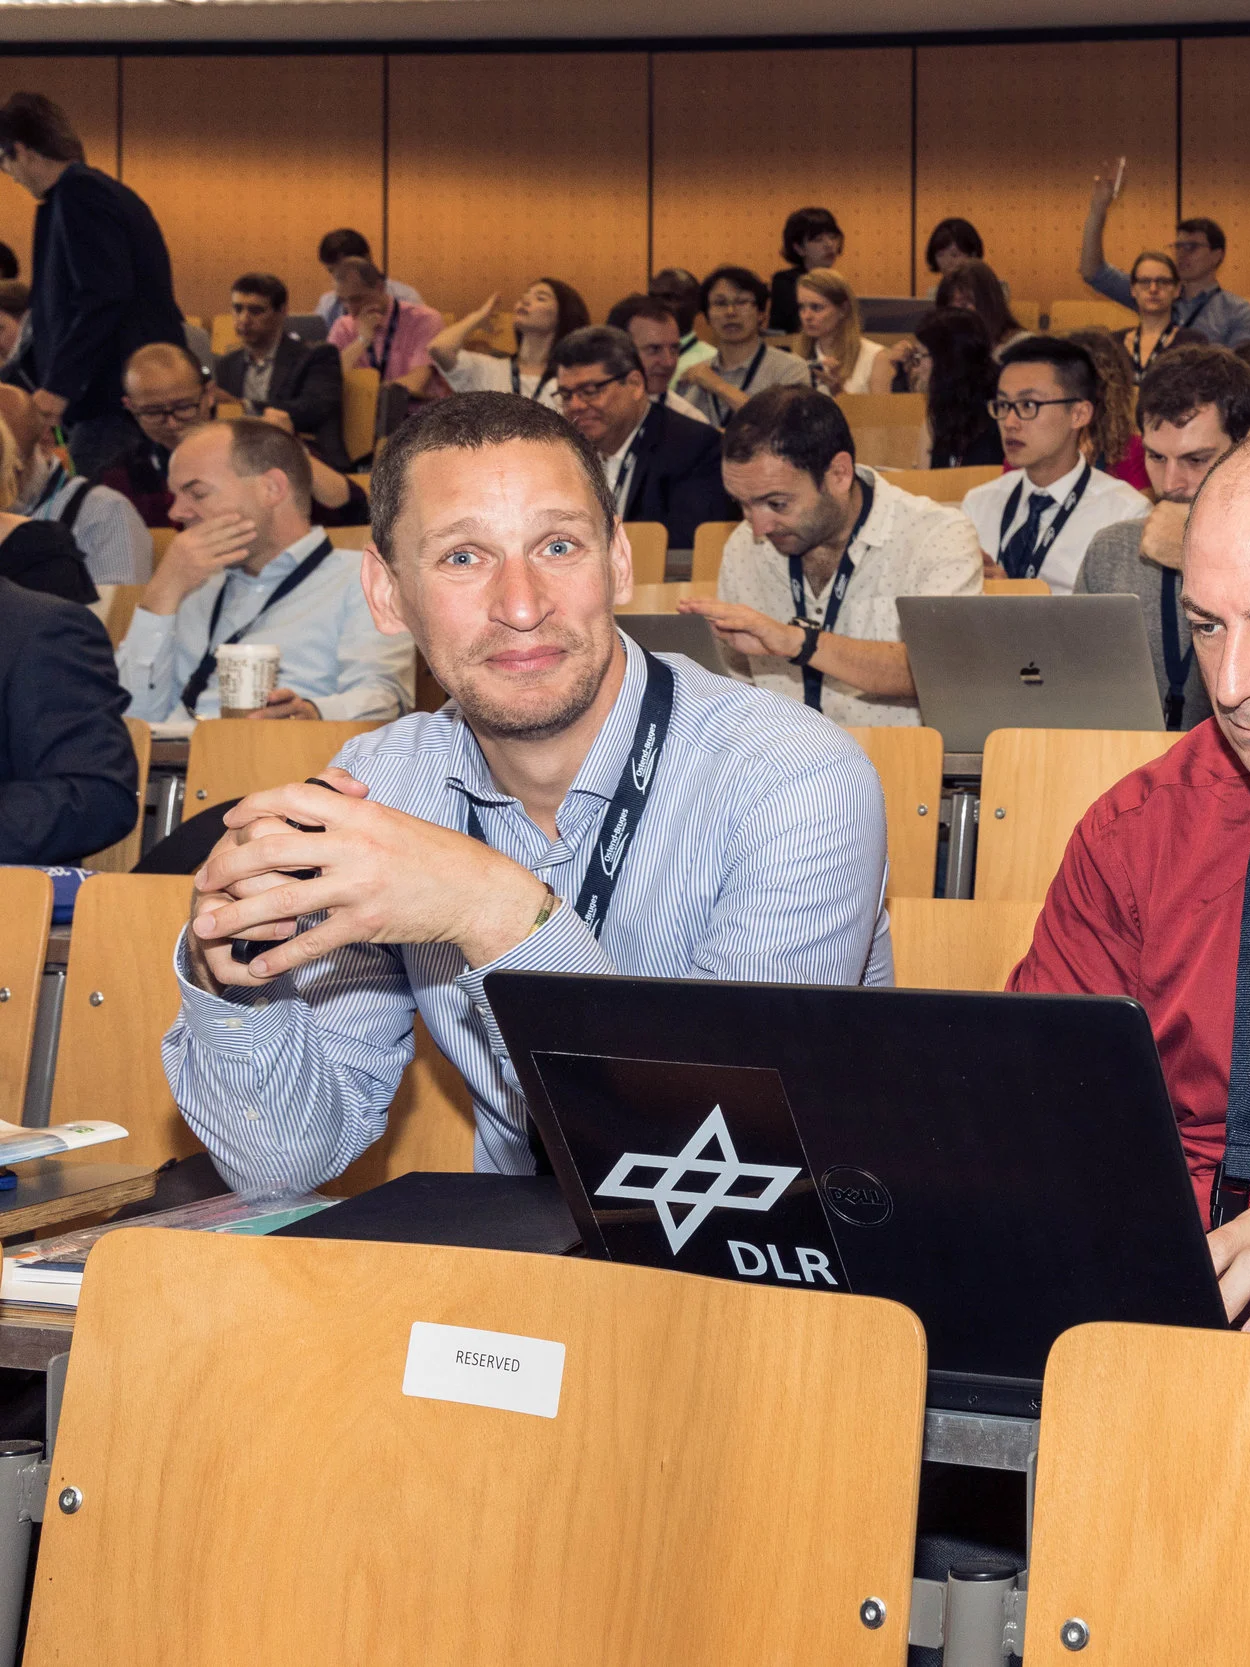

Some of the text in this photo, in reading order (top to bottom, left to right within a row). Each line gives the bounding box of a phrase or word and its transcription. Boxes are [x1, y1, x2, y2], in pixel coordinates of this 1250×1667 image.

[636, 723, 656, 776] Ostend-Bruges
[604, 808, 628, 862] Ostend-Bruges
[828, 1186, 887, 1206] DELL
[727, 1240, 838, 1285] DLR
[456, 1350, 520, 1372] RESERVED
